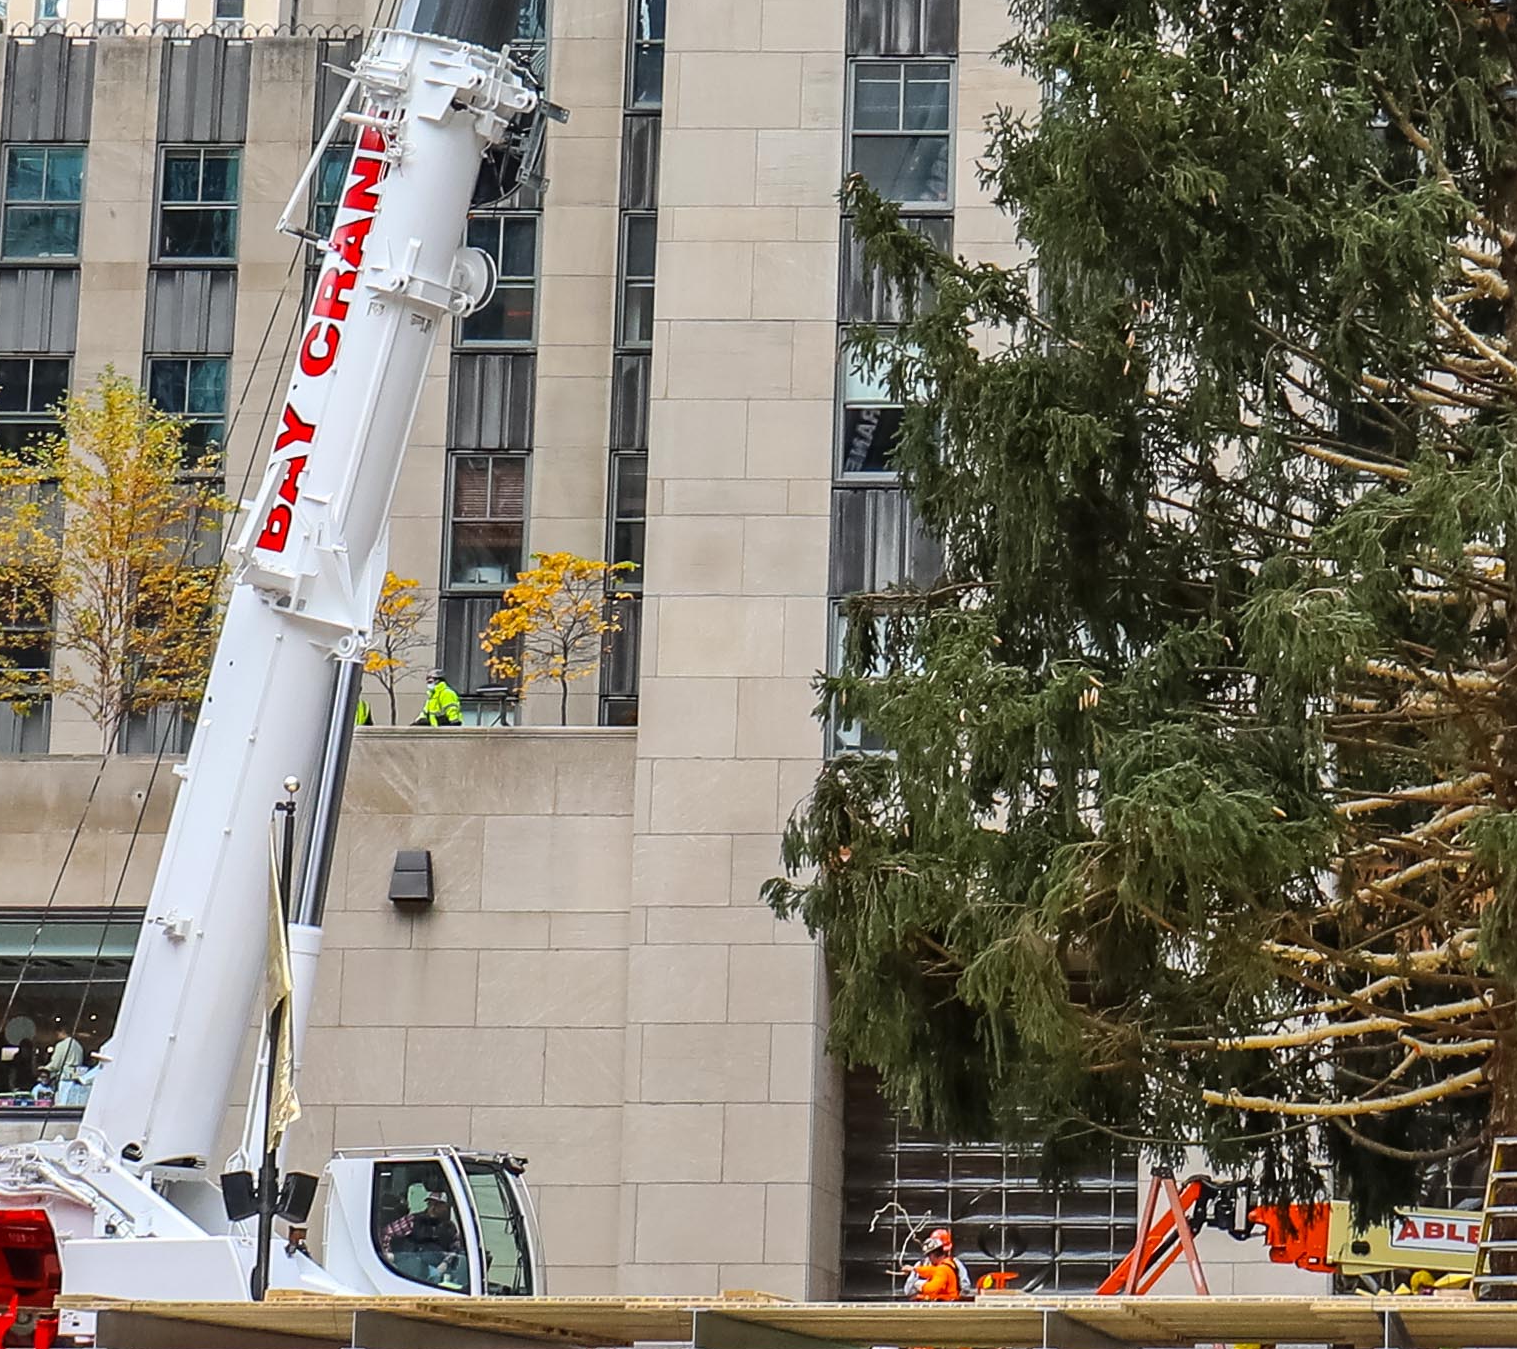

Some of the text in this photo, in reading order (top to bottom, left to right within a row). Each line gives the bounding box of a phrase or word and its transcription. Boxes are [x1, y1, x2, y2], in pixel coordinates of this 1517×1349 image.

[256, 106, 390, 553] BAY CRANE
[1395, 1217, 1481, 1246] ABLE
